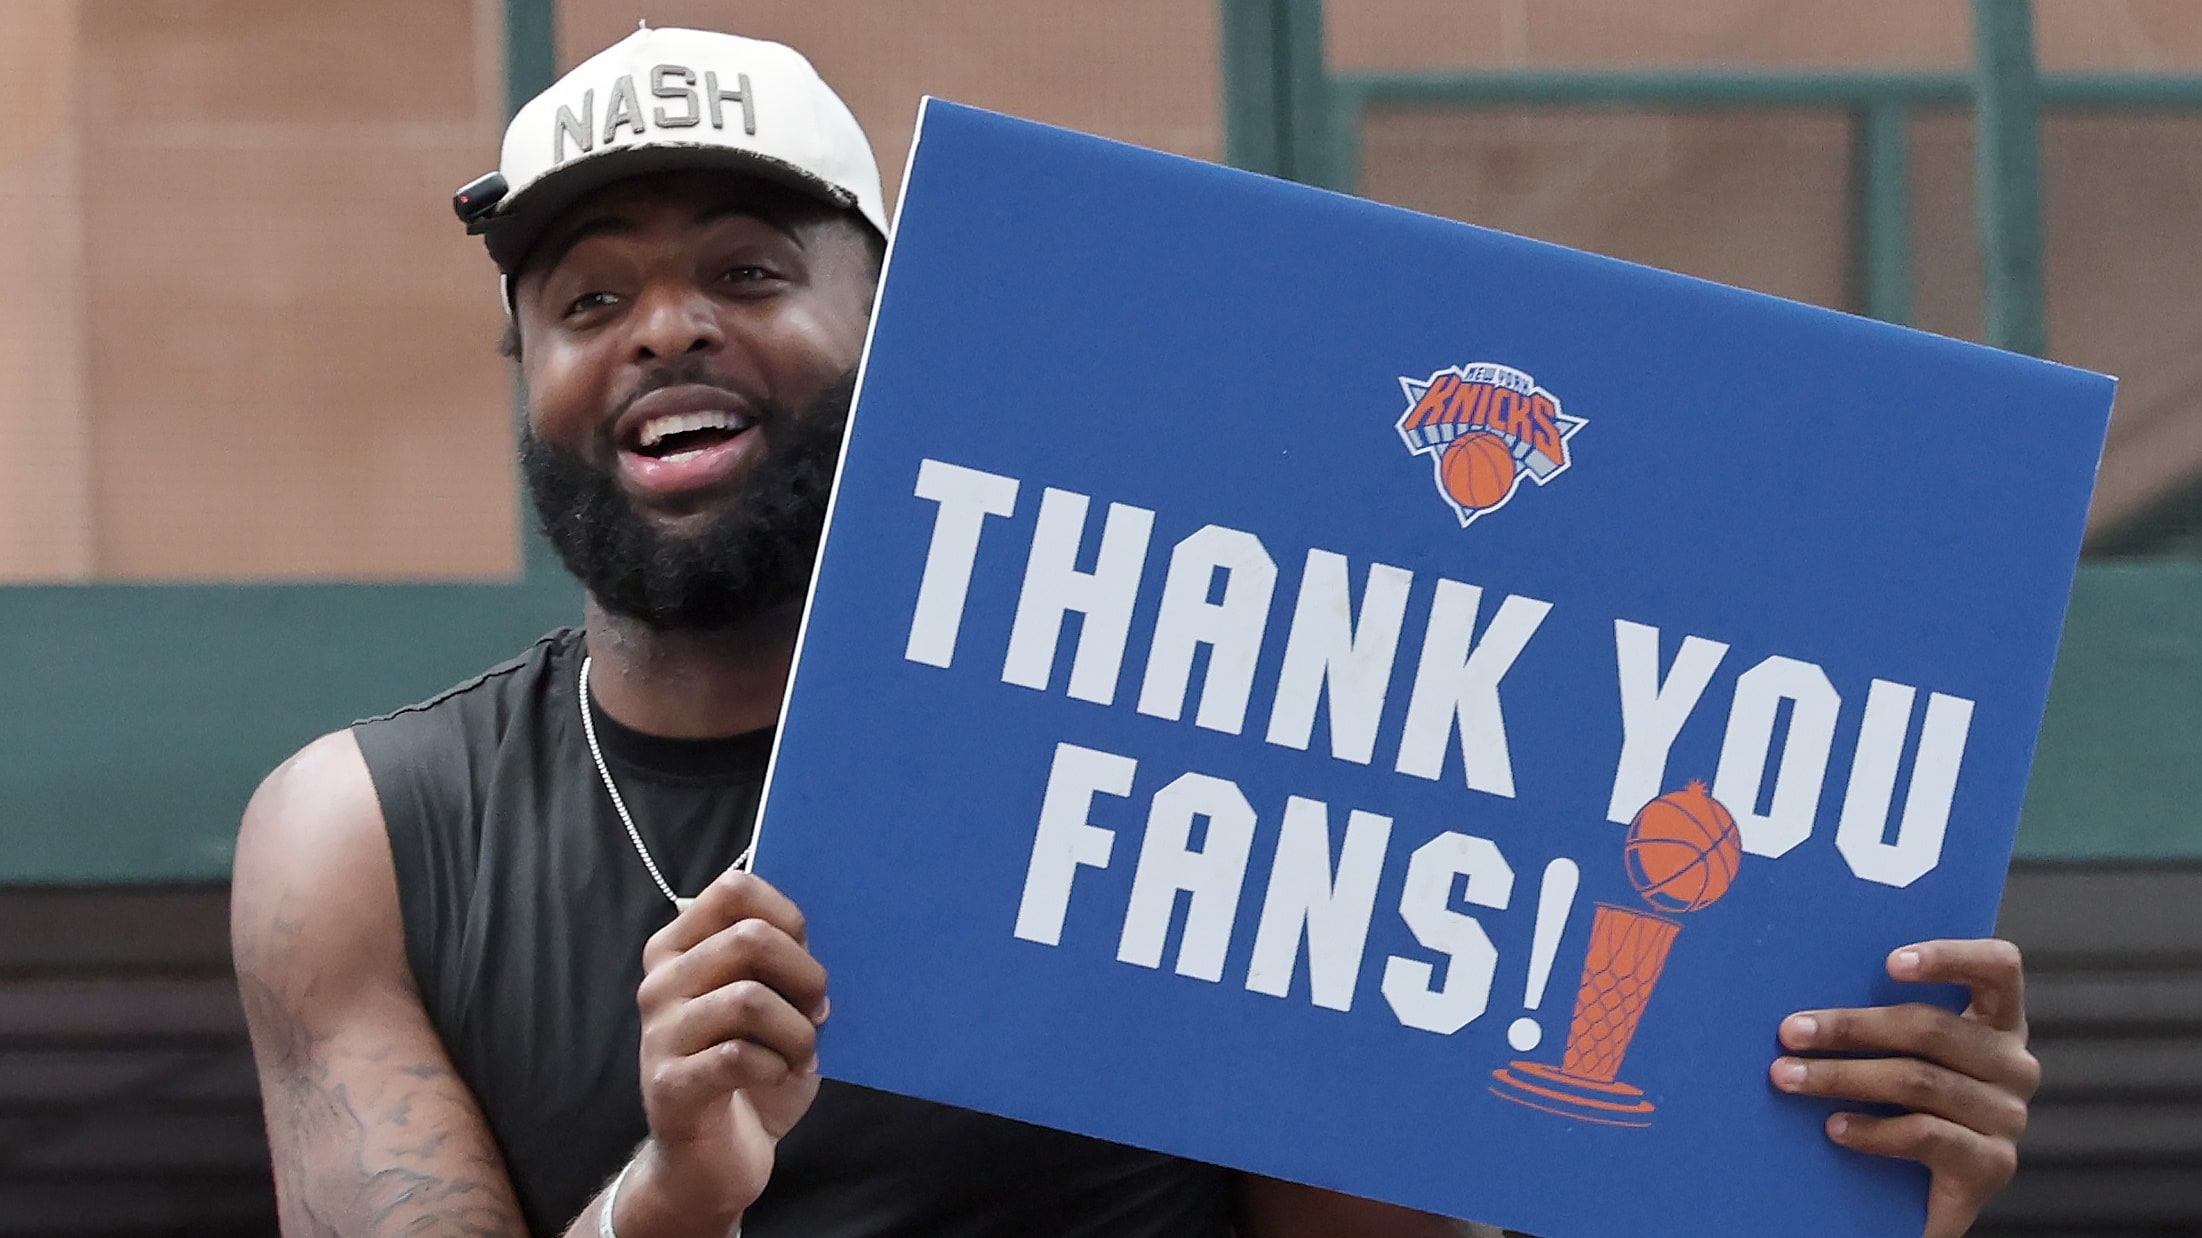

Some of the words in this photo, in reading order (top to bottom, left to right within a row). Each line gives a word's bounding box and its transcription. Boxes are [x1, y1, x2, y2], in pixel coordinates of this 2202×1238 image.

[553, 64, 756, 164] NASH
[1404, 375, 1564, 466] KNICKS
[1464, 367, 1497, 381] NEW
[1499, 369, 1530, 395] YORK
[905, 459, 1554, 799] THANK
[1606, 619, 1975, 888] YOU
[1014, 742, 1580, 1052] FANS!
